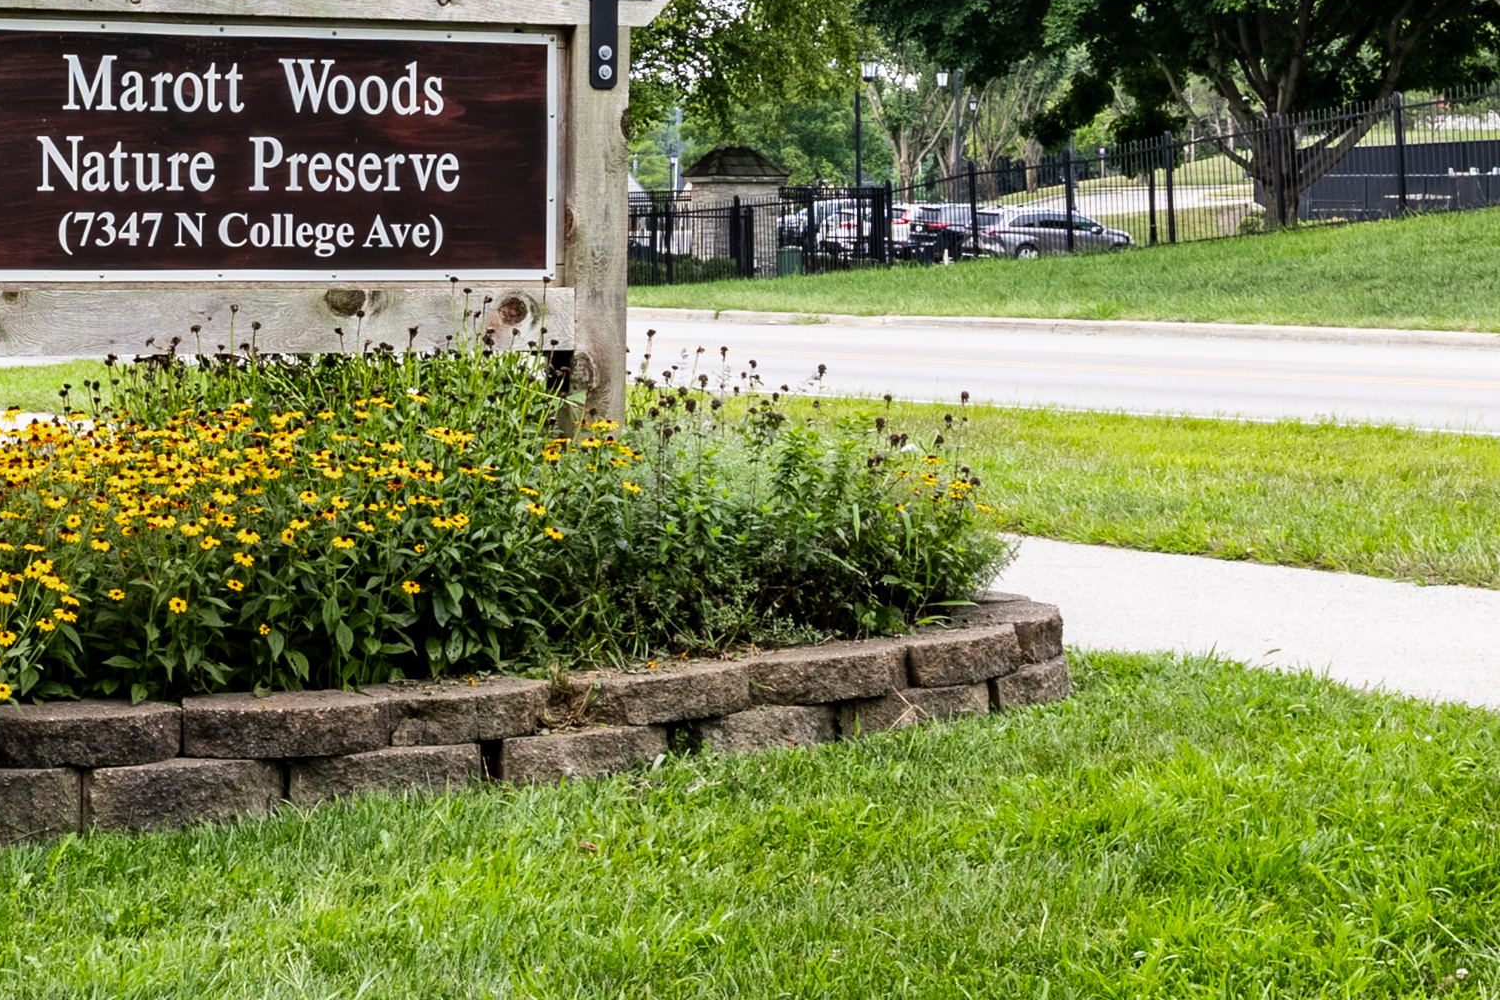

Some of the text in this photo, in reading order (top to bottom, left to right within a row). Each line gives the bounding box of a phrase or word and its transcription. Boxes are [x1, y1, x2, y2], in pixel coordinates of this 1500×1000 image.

[62, 54, 445, 116] Marott Woods
[36, 135, 460, 192] Nature Preserve
[58, 211, 444, 258] (7347 N College Ave)
